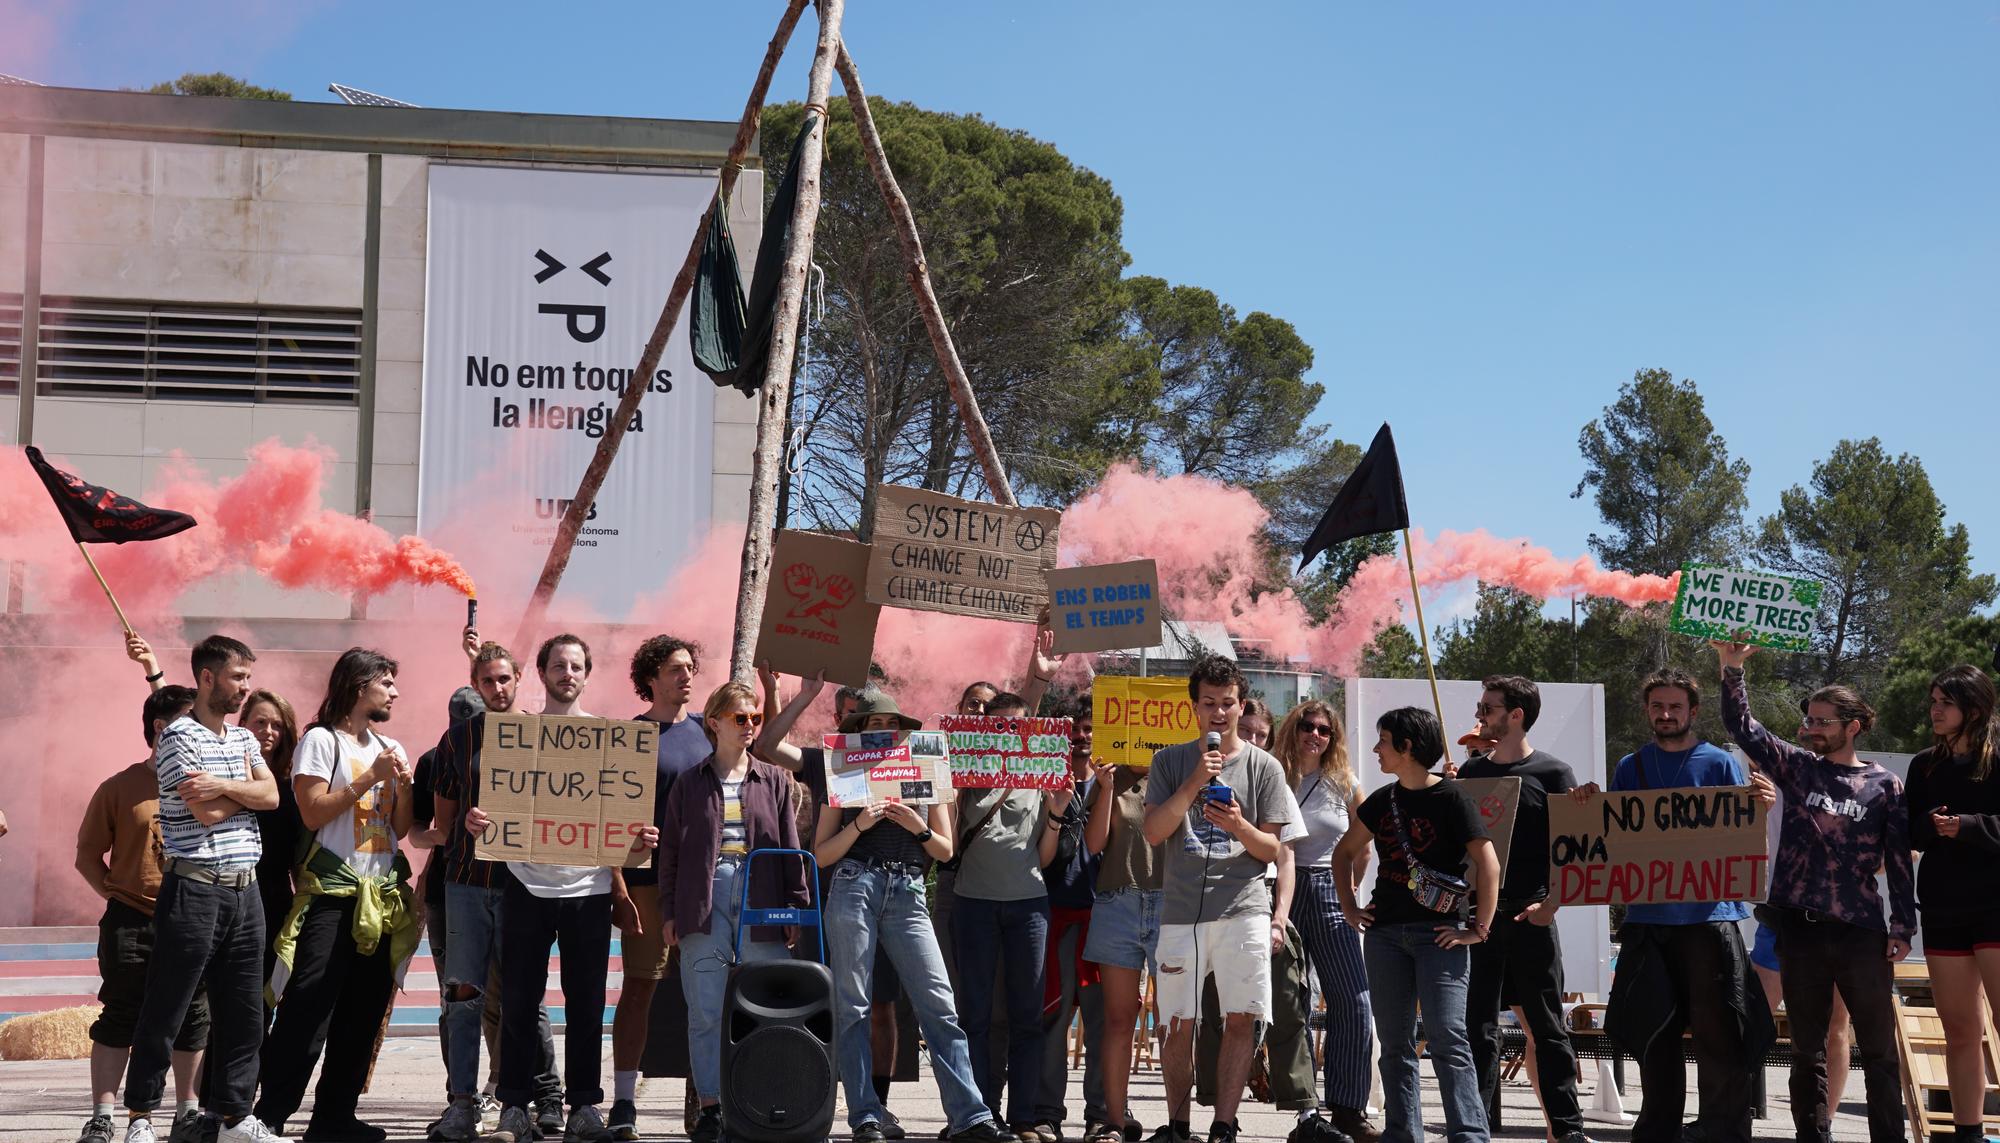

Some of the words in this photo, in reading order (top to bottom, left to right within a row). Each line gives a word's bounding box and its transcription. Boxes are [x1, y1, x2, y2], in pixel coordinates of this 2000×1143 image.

[466, 355, 509, 388] No
[517, 364, 565, 389] em
[493, 397, 520, 428] la
[906, 503, 1003, 547] SYSTEM
[891, 543, 965, 576] CHANGE
[977, 555, 1014, 580] NOT
[887, 575, 953, 605] CLIMATE
[959, 586, 1033, 615] CHANGE
[1056, 587, 1087, 607] ENS
[1092, 583, 1152, 603] ROBEN
[1693, 571, 1724, 592] WE
[1730, 577, 1785, 602] NEED
[1065, 612, 1085, 629] EL
[1089, 607, 1146, 627] TEMPS
[1686, 594, 1749, 622] MORE
[1755, 604, 1813, 633] TREES
[1103, 696, 1201, 731] DEGRO
[498, 722, 533, 749] EL
[541, 724, 653, 754] NOSTRE
[847, 751, 882, 762] OCUPAR
[885, 747, 906, 757] FINS
[949, 733, 1022, 749] NUESTRA
[1027, 736, 1069, 752] CASA
[1112, 740, 1128, 749] or
[872, 768, 918, 778] GUANYAR!
[982, 754, 1002, 769] EN
[1005, 757, 1065, 773] LLAMAS
[1603, 795, 1645, 837] NO
[483, 819, 523, 848] DE
[533, 819, 645, 853] TOTES
[1552, 833, 1588, 867] ON
[1559, 861, 1645, 904] DEAD
[1648, 855, 1769, 901] PLANET
